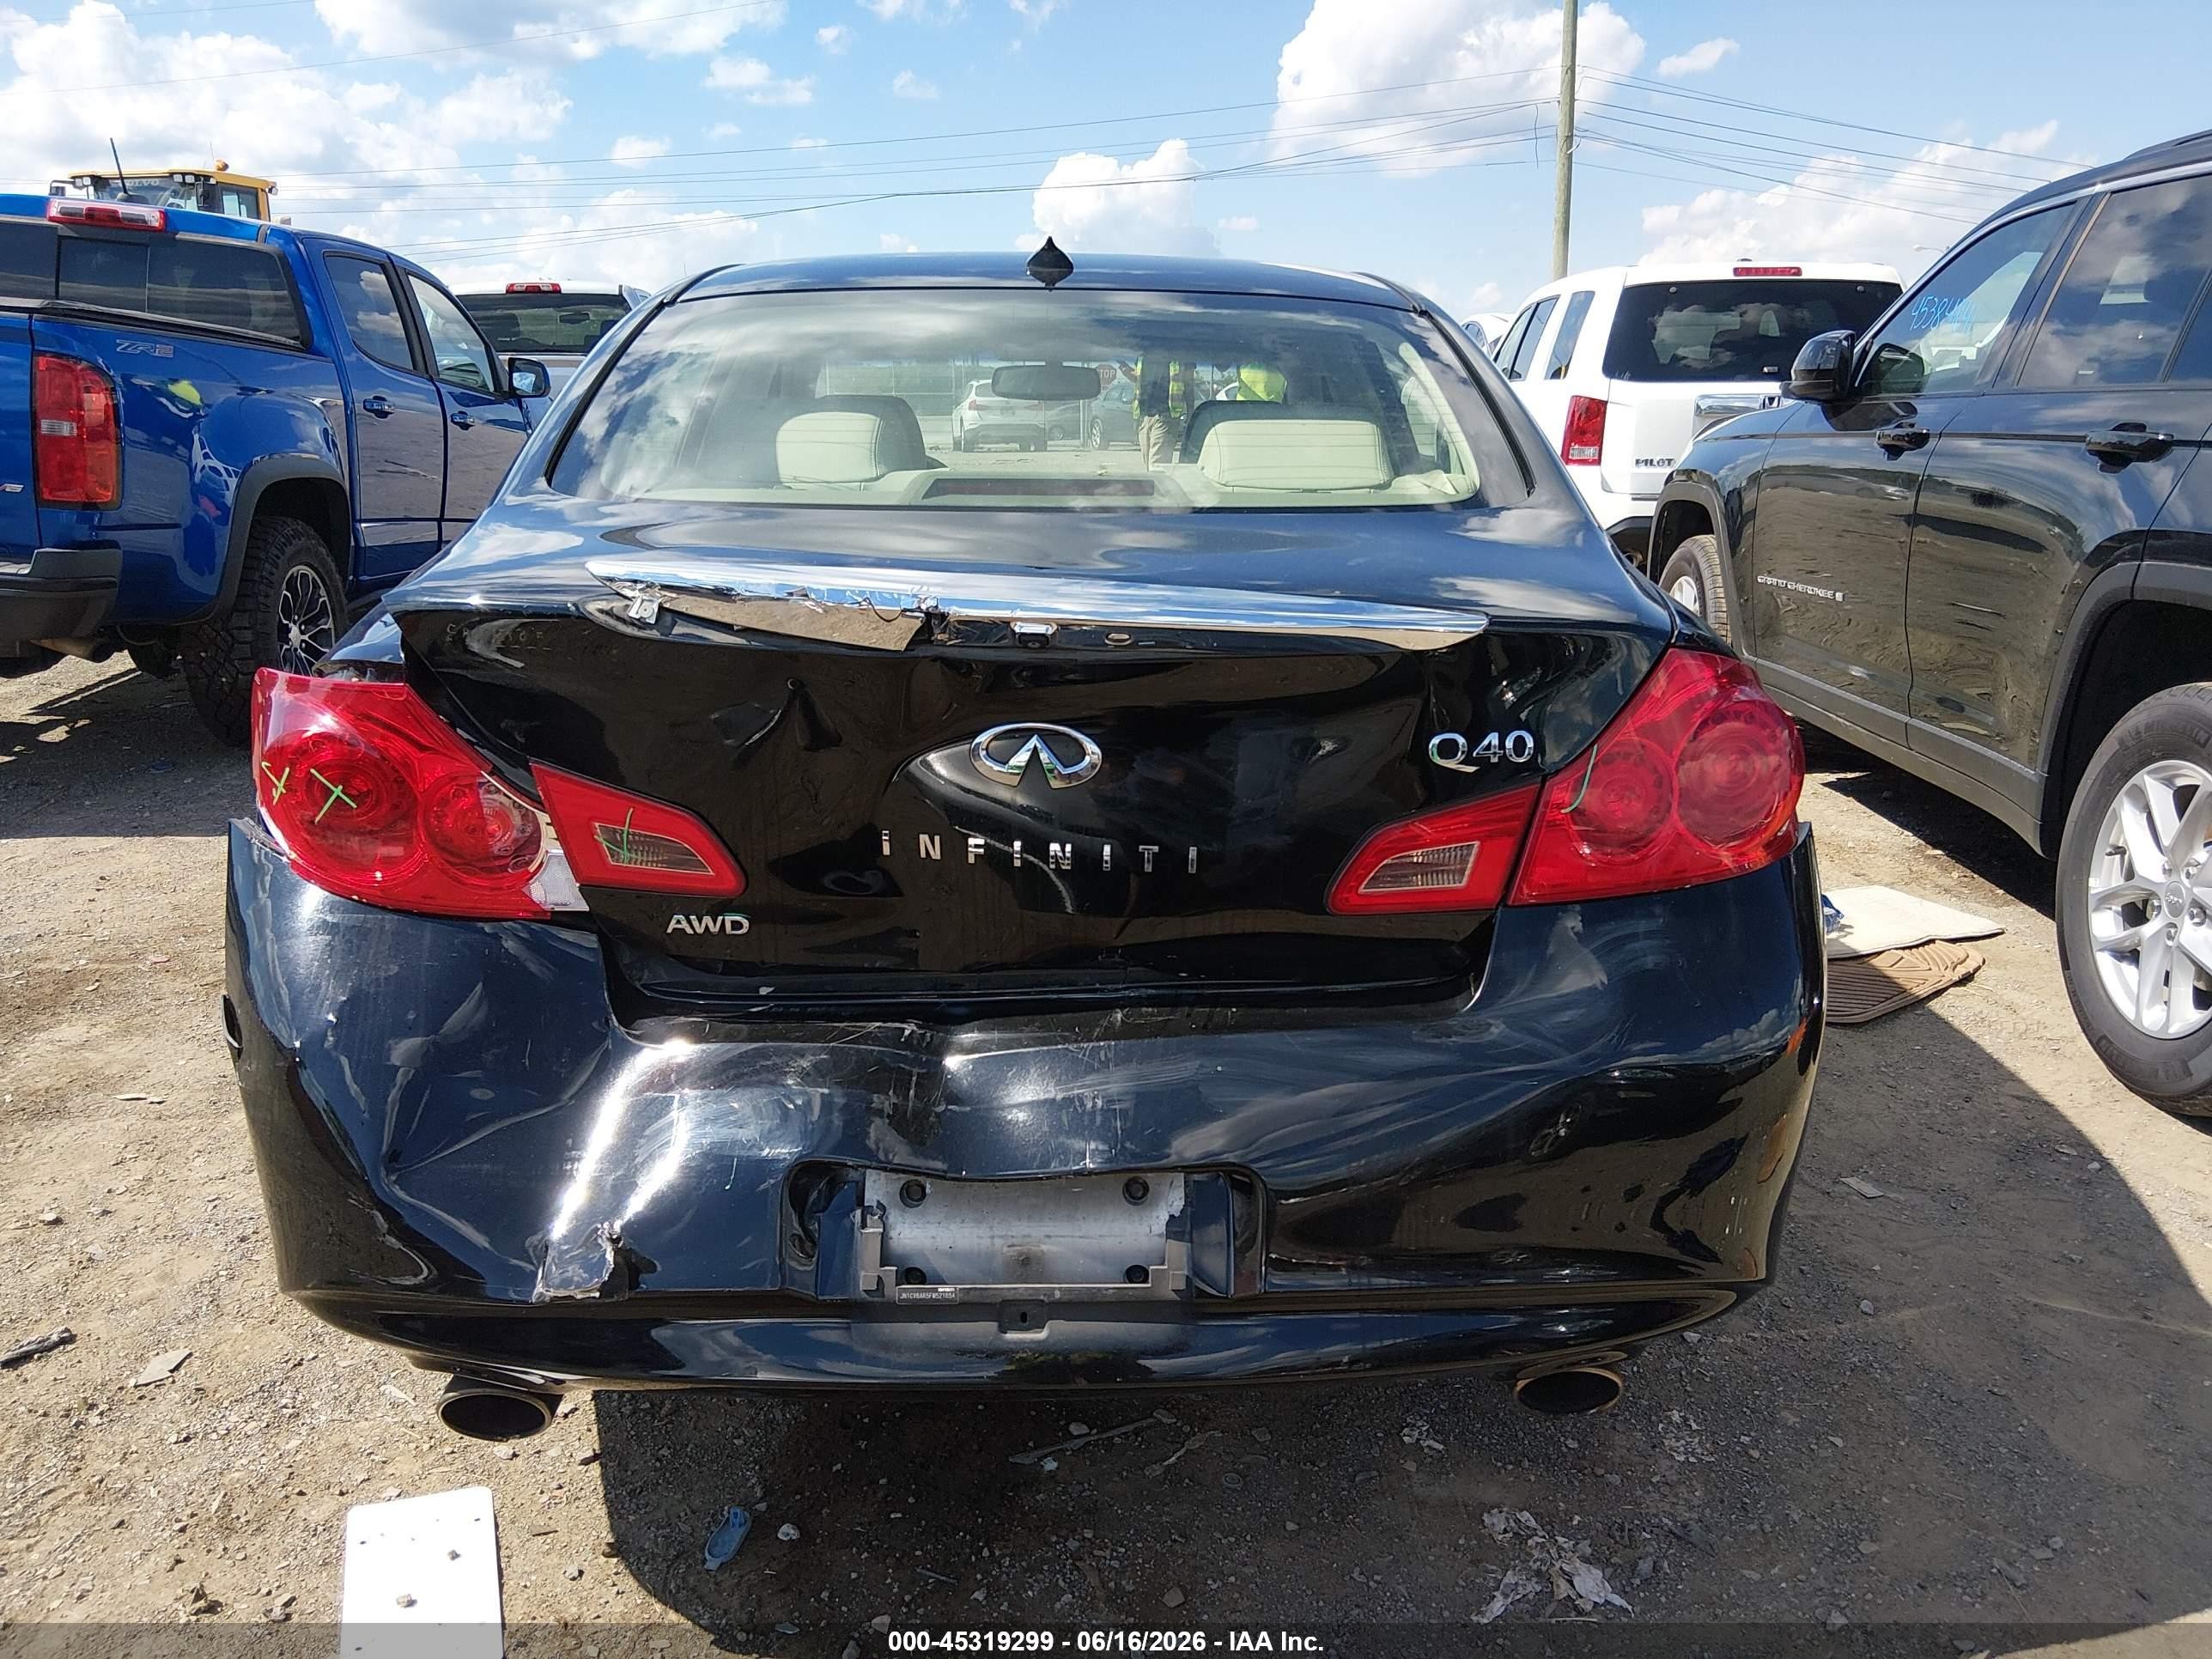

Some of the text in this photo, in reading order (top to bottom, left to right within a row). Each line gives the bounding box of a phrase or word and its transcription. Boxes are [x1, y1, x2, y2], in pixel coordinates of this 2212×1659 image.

[116, 339, 174, 358] ZR2
[1098, 369, 1115, 379] TOP
[1635, 458, 1675, 468] PILOT
[1757, 575, 1835, 599] GRAND CHEROKEE
[1428, 730, 1534, 773] Q40
[882, 830, 1198, 874] INFINITI
[665, 915, 750, 935] AWD
